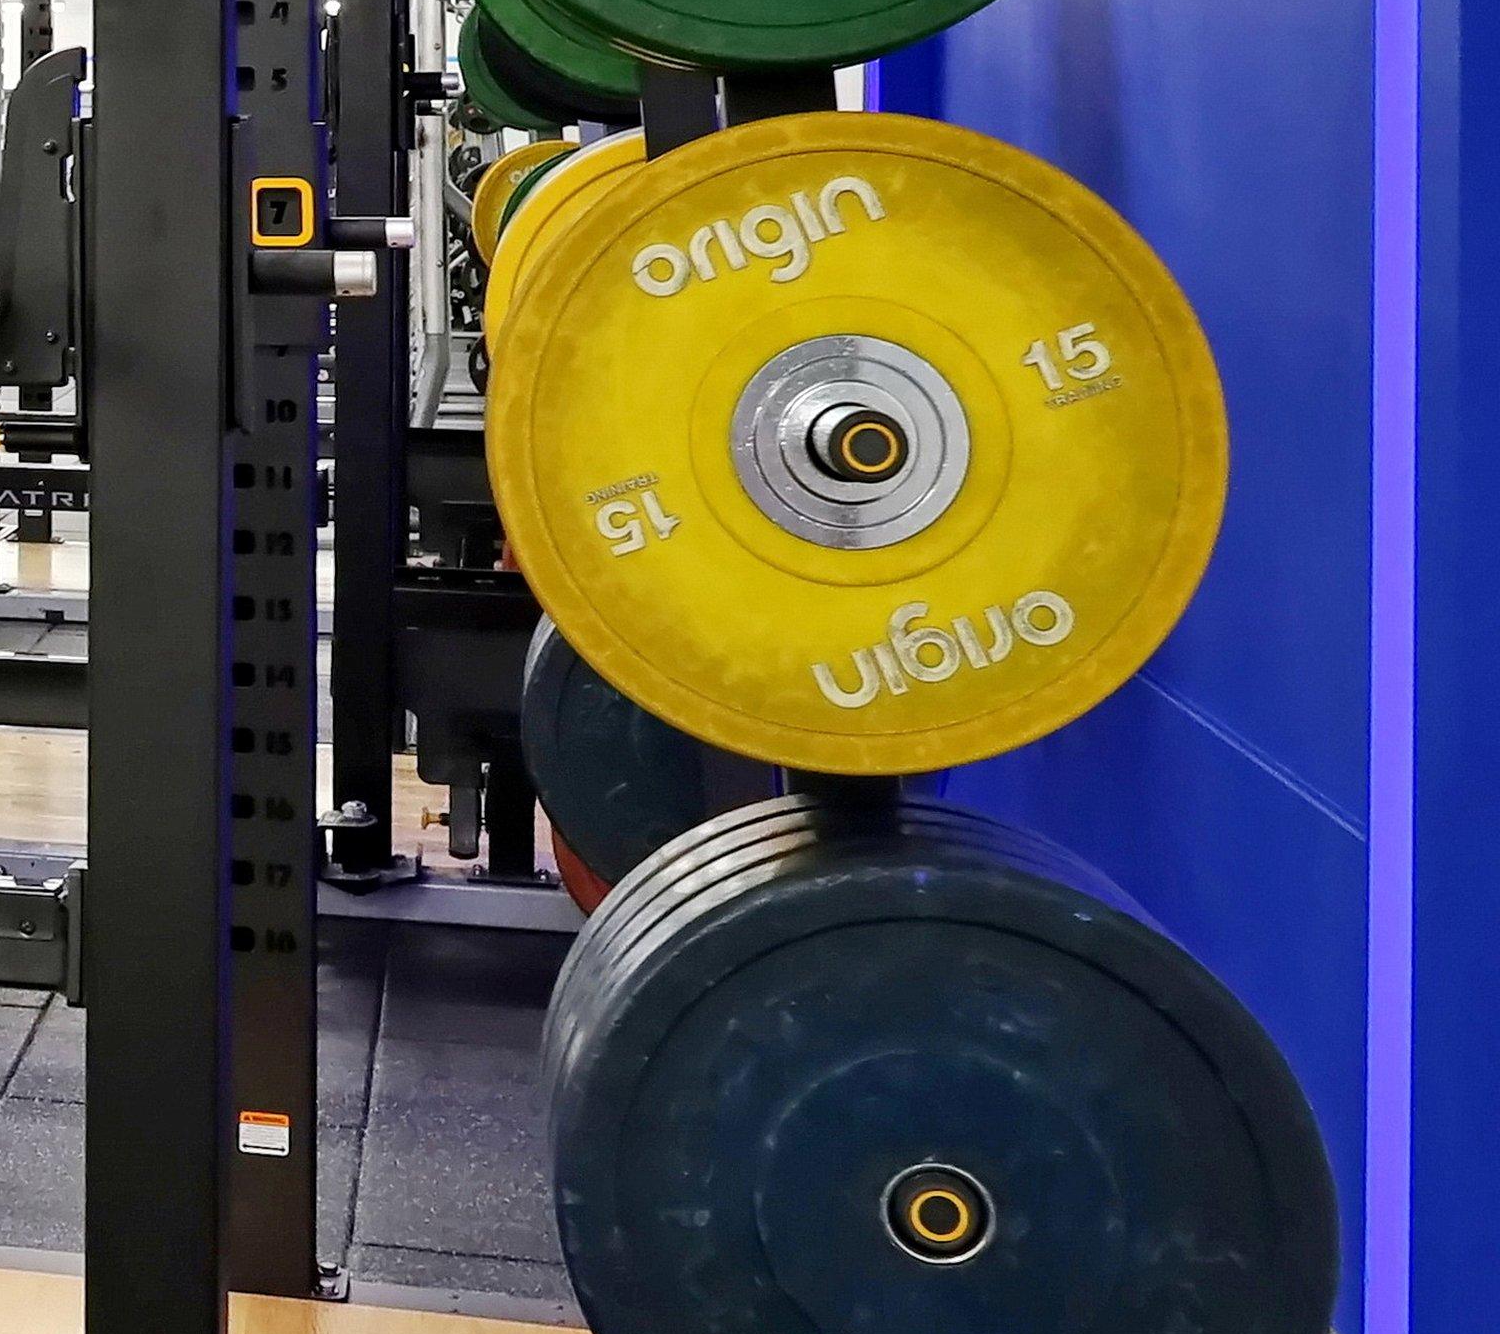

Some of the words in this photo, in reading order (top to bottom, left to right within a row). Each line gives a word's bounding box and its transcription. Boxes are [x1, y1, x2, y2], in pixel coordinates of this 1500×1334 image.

[270, 1, 289, 25] 4
[271, 68, 287, 92] 5
[269, 201, 288, 224] 7
[631, 175, 887, 298] origin
[1022, 322, 1111, 391] 15
[266, 399, 297, 423] 10
[265, 466, 292, 490] 11
[585, 473, 660, 504] TRAINING
[594, 490, 682, 557] 15
[810, 591, 1076, 710] origin
